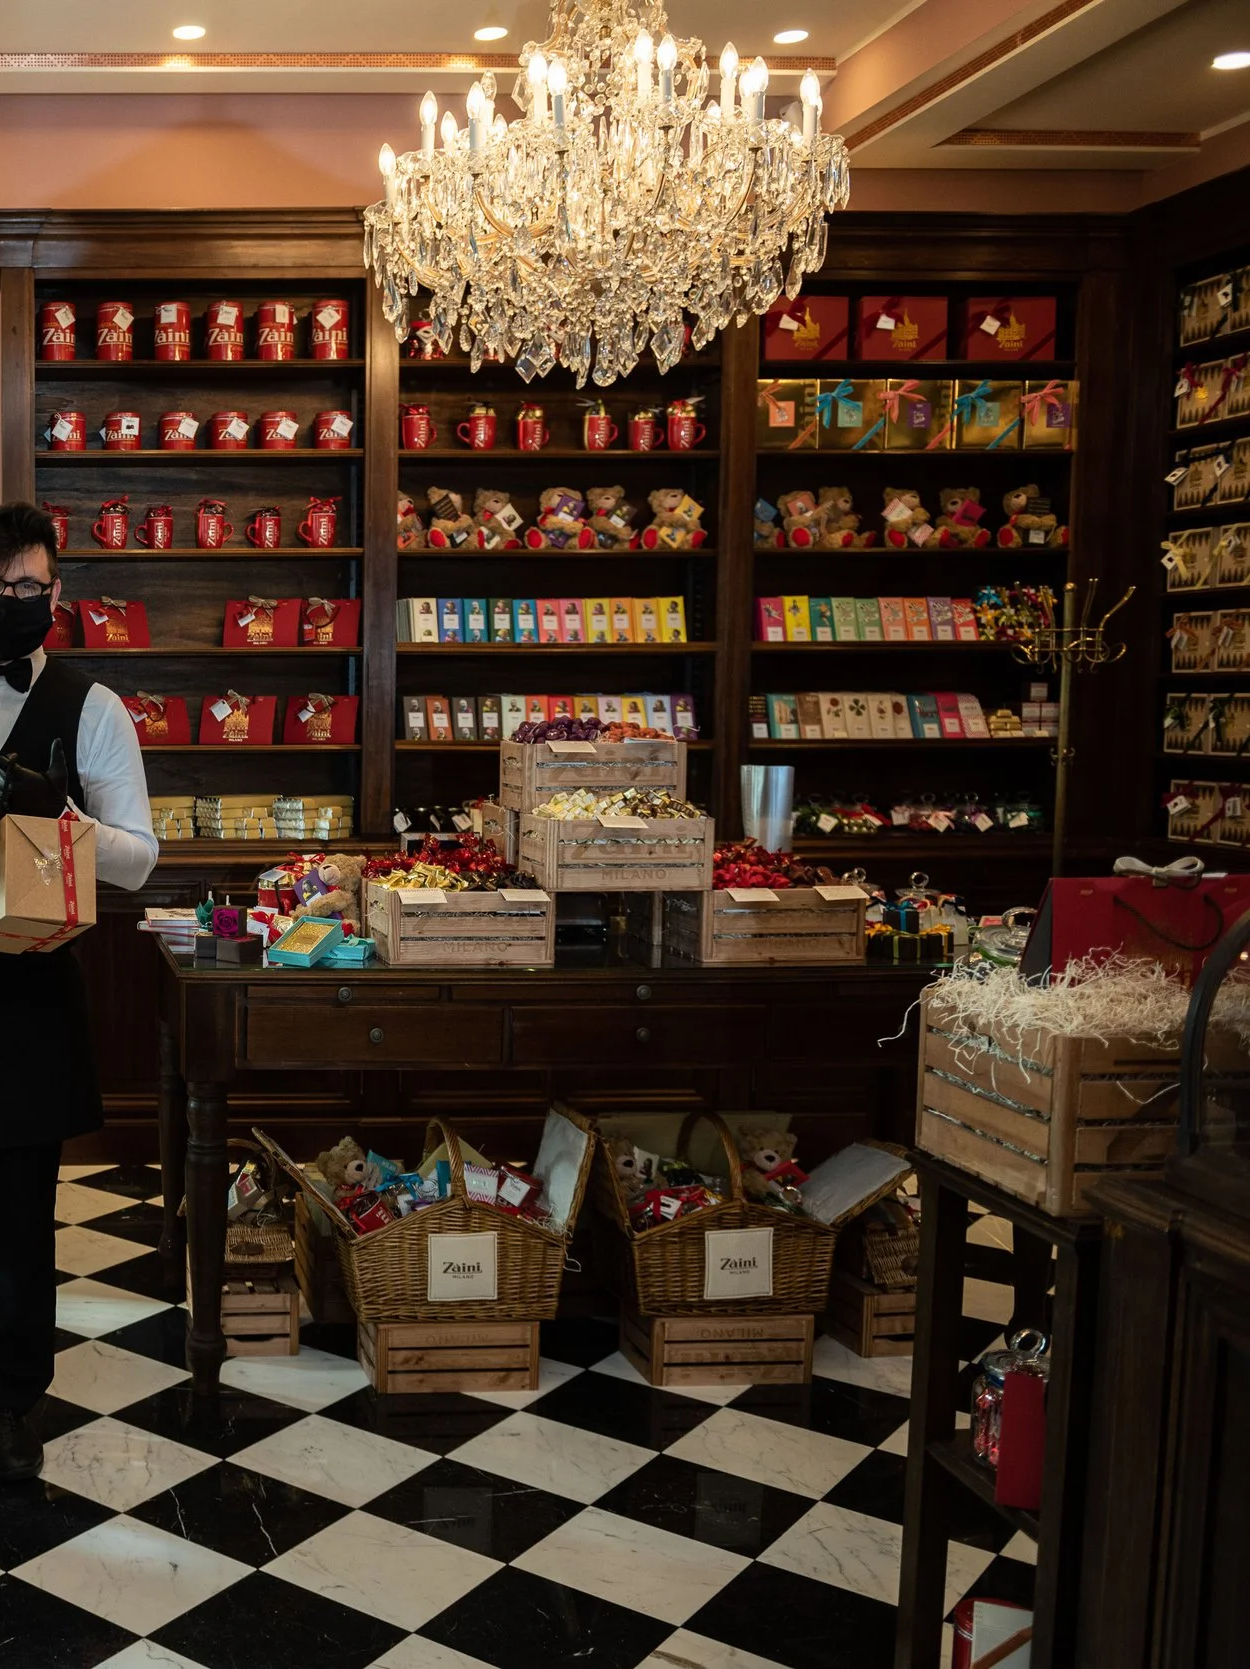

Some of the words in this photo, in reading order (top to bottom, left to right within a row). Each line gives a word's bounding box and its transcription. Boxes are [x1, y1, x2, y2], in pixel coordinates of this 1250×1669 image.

[602, 869, 667, 880] MILANO
[443, 941, 508, 953] MILANO
[700, 1327, 764, 1339] MILANO
